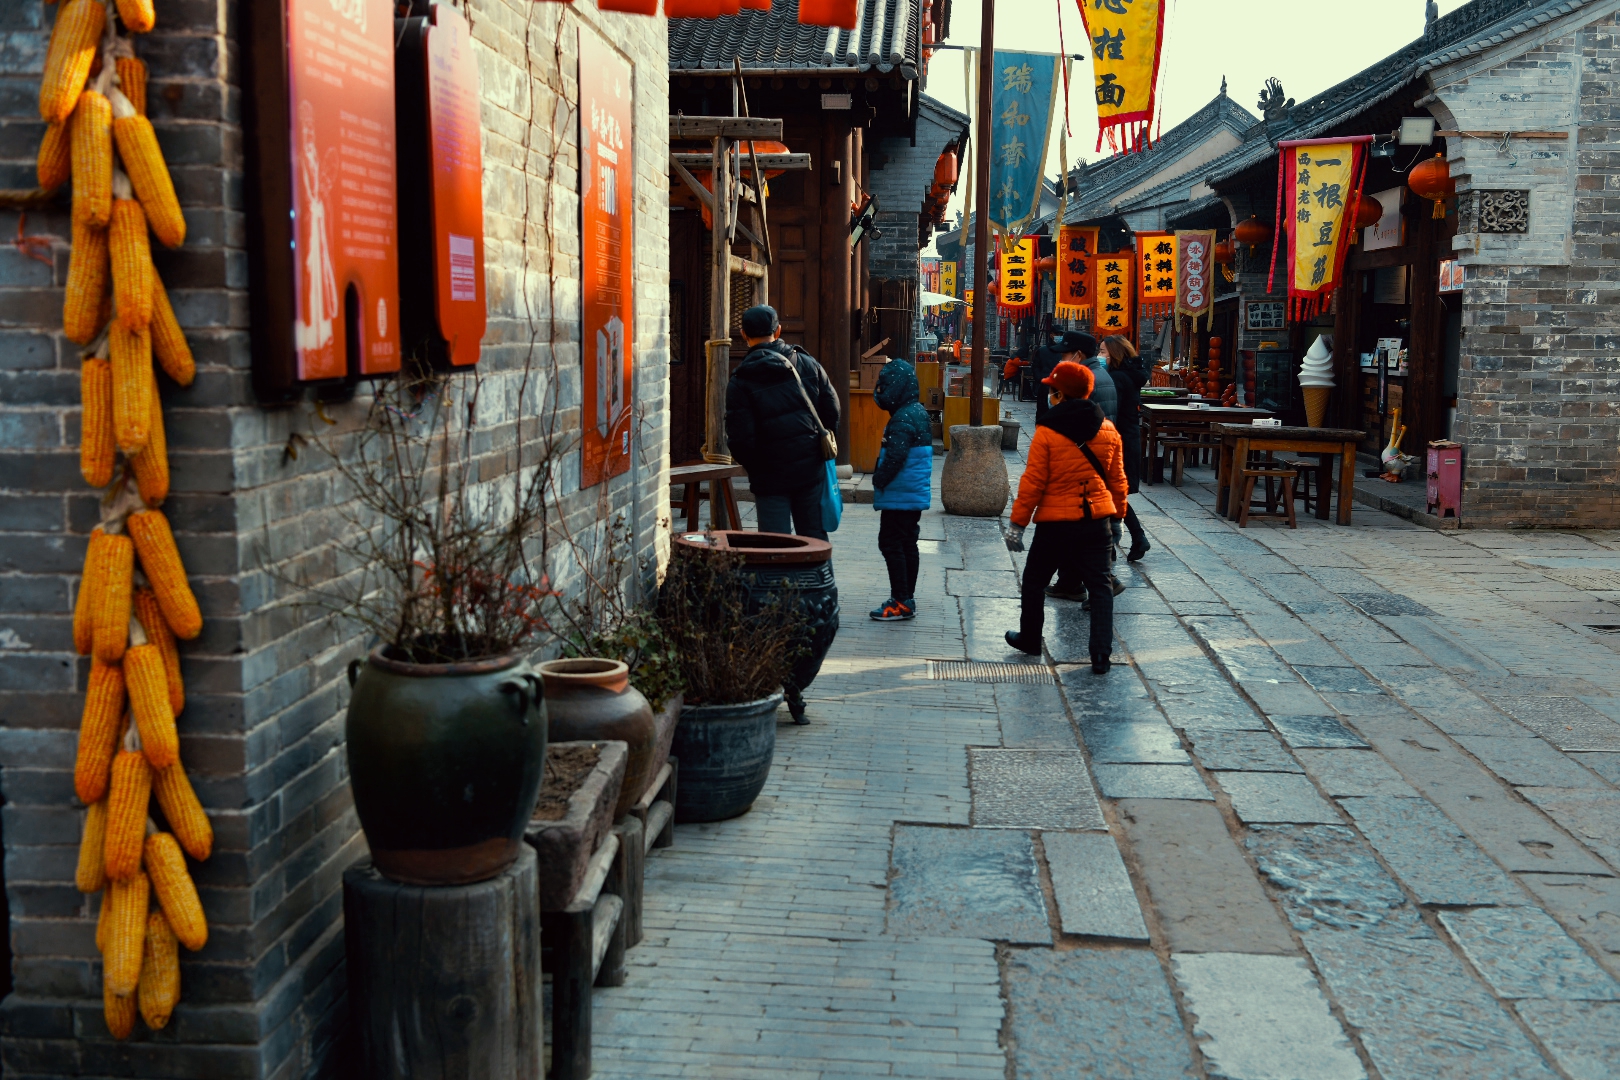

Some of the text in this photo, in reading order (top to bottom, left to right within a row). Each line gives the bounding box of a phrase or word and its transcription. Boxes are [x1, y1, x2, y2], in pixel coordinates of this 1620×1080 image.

[1311, 158, 1343, 286] 一根豆筋
[1067, 236, 1088, 298] 酸梅汤
[1187, 242, 1203, 306] 冰糖葫芦
